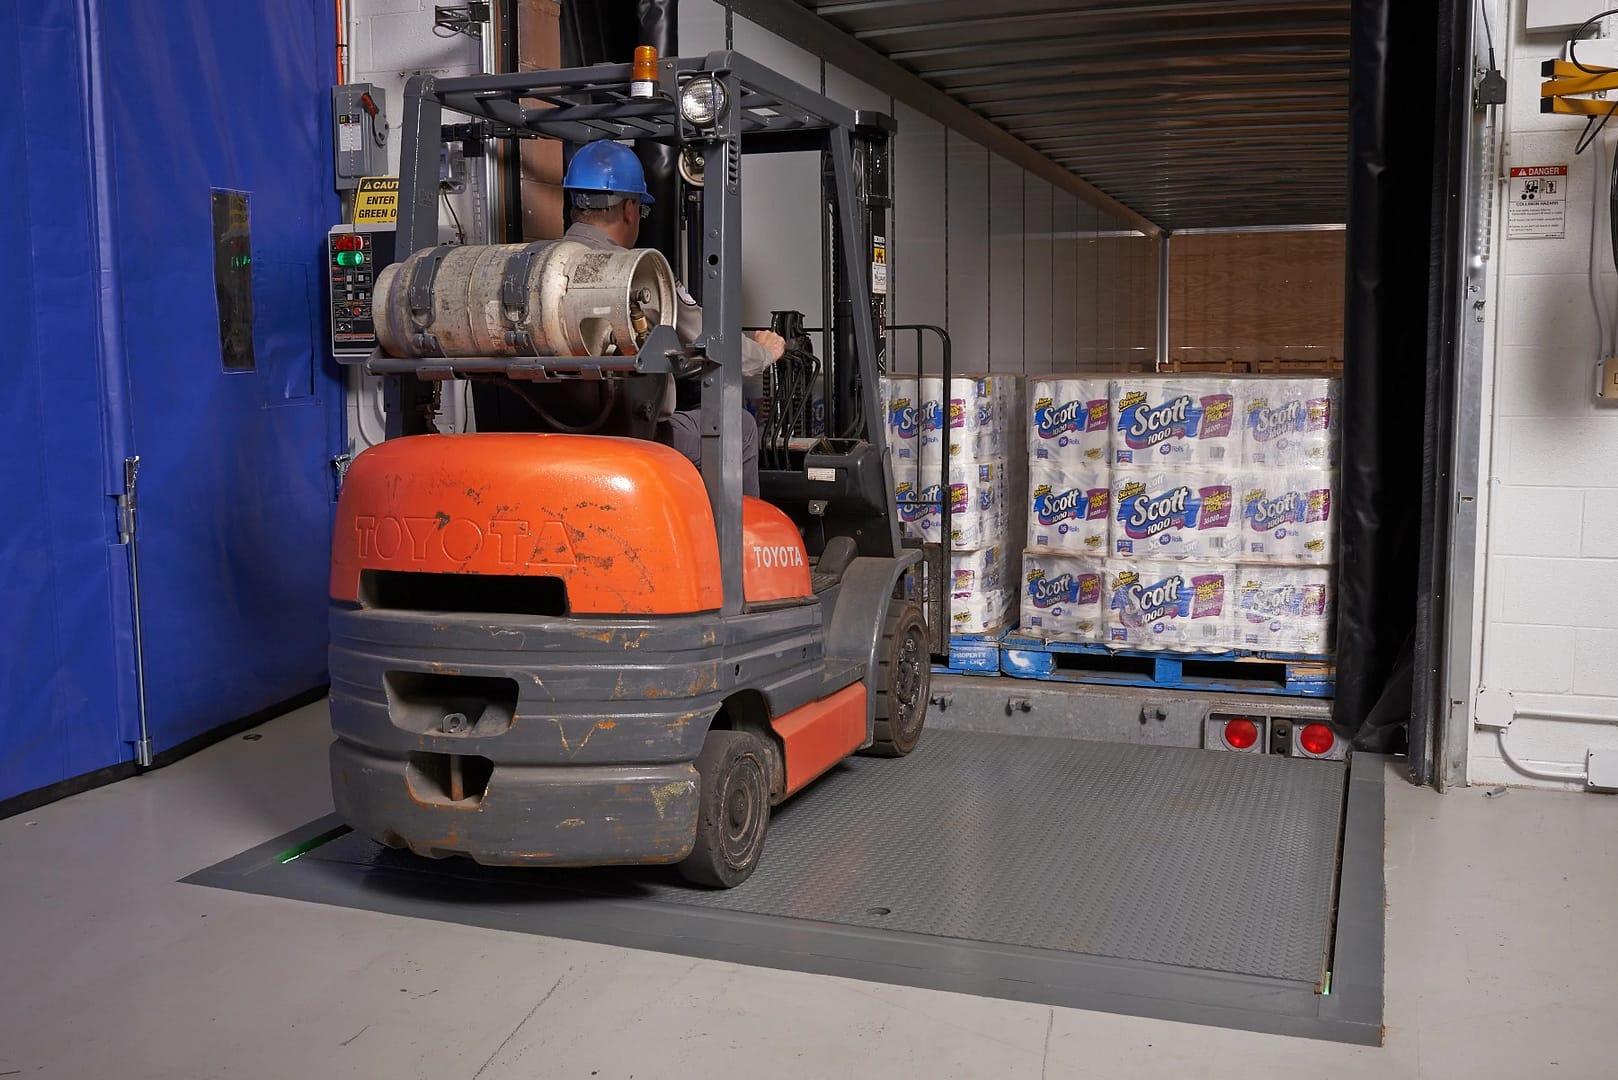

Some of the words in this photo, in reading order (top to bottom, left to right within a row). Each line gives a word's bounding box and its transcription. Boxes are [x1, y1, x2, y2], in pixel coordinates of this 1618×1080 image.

[1528, 167, 1560, 176] DANGER
[366, 195, 395, 205] ENTER
[358, 208, 388, 218] GREEN
[1041, 400, 1079, 430] Scott
[1130, 395, 1190, 437] Scott
[1256, 400, 1300, 432] Scott
[1147, 426, 1172, 446] 1000
[1160, 445, 1170, 453] 36
[1041, 488, 1080, 516] Scott
[1130, 486, 1189, 526] Scott
[1254, 491, 1298, 522] Scott
[1052, 511, 1067, 523] 1000
[1146, 517, 1171, 535] 1000
[1267, 514, 1285, 529] 1000
[355, 514, 578, 567] TOYOTA
[1160, 535, 1170, 543] 36
[1171, 535, 1183, 543] Rolls
[752, 546, 804, 568] TOYOTA
[1035, 574, 1071, 599] Scott
[1124, 575, 1181, 614] Scott
[1141, 606, 1164, 624] 1000
[1153, 623, 1164, 631] 36
